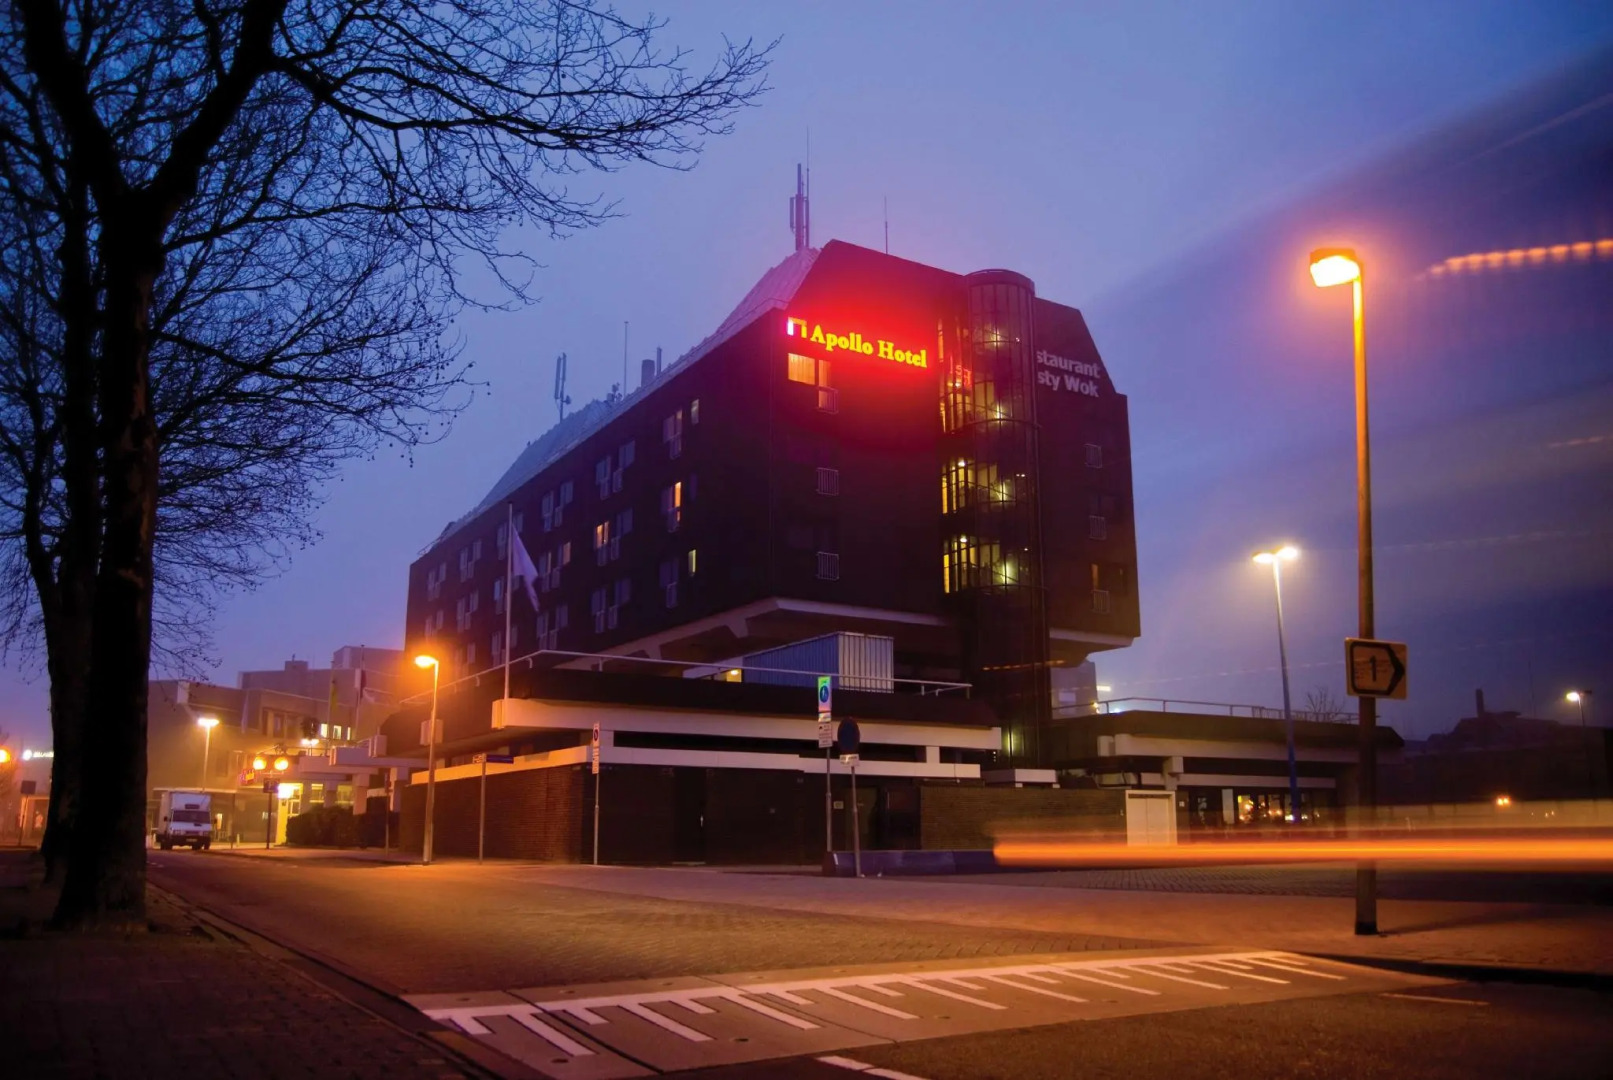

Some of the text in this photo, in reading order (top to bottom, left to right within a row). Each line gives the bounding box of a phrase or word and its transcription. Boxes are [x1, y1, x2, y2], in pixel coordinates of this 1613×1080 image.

[810, 324, 928, 368] Apollo Hotel
[1063, 374, 1100, 398] Wok
[1369, 655, 1377, 682] 1
